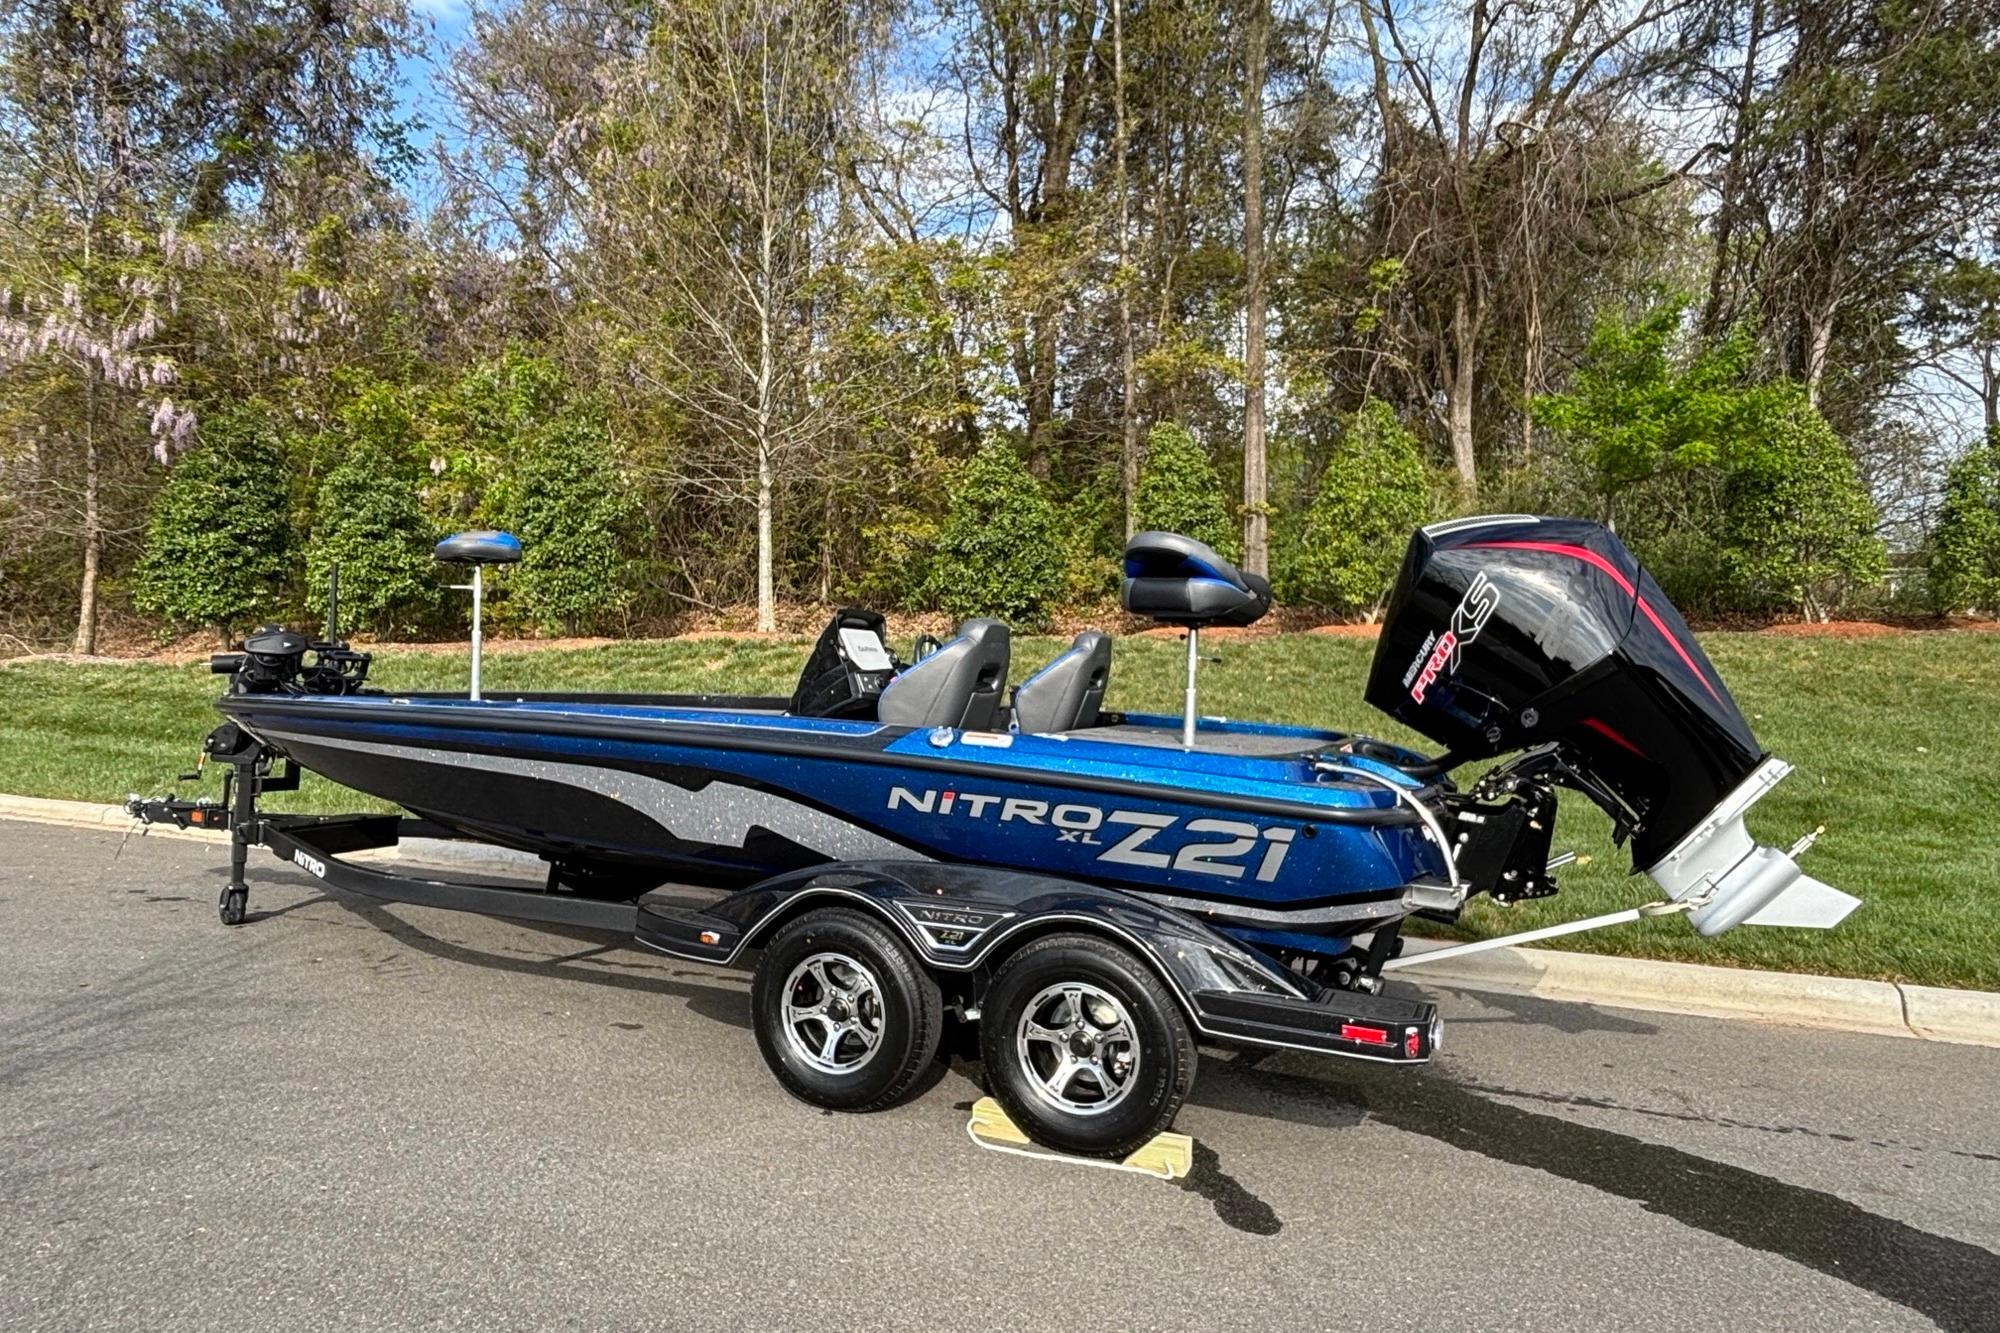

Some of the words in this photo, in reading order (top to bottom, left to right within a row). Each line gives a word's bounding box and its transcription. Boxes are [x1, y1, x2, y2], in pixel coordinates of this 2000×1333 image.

[1402, 630, 1436, 689] MERCURY
[1411, 631, 1457, 705] PRO
[1450, 570, 1500, 676] XS
[1056, 828, 1102, 845] XL
[1097, 810, 1296, 883] Z21
